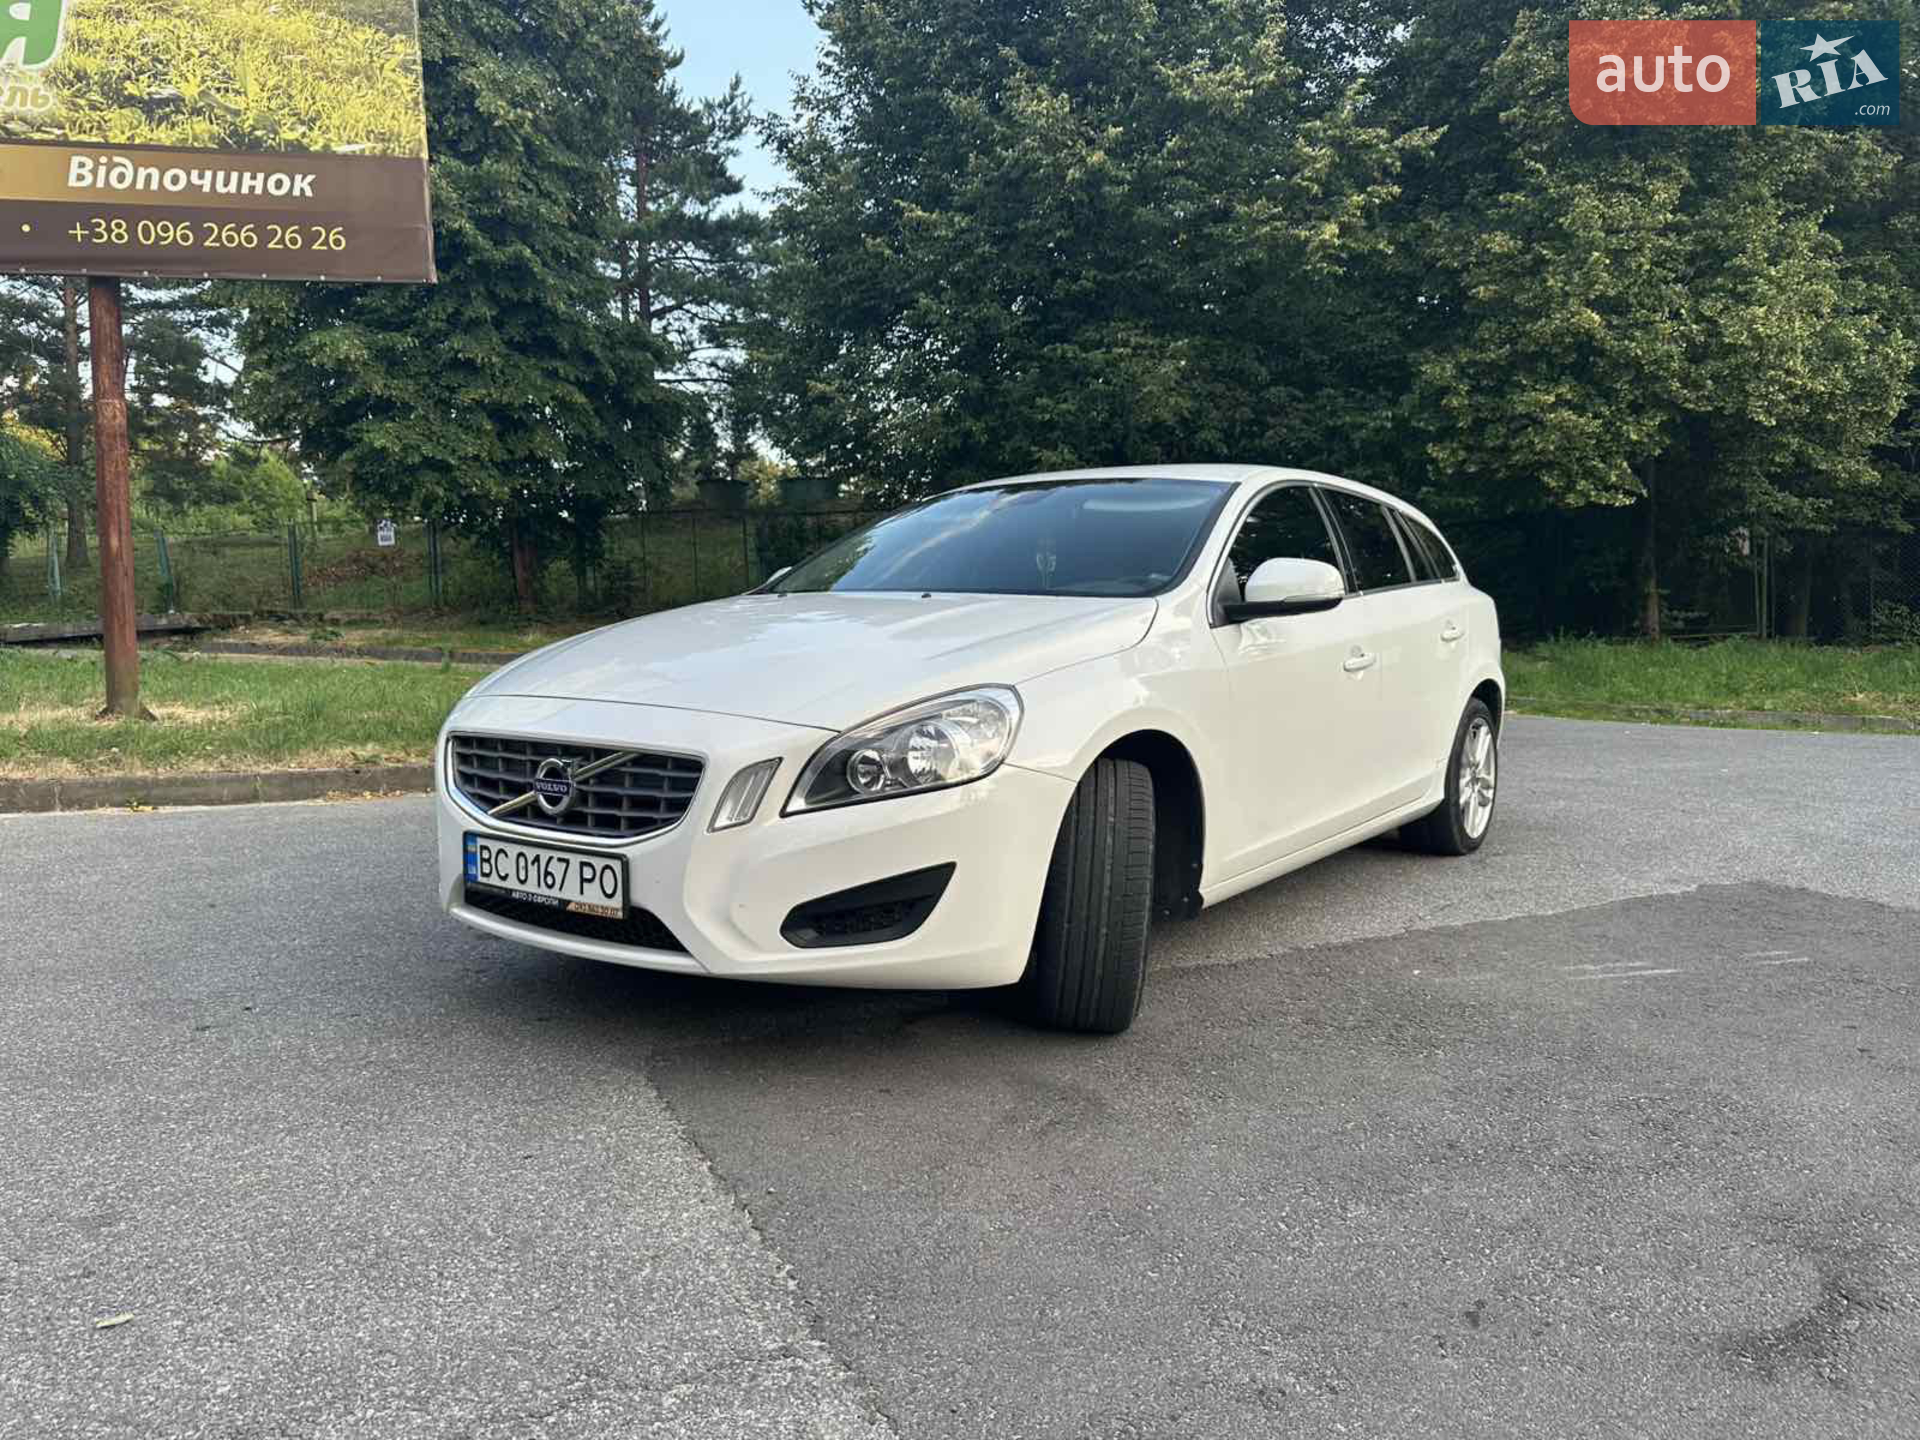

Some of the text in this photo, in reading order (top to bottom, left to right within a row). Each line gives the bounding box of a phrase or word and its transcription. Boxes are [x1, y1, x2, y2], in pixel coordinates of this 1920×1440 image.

[0, 84, 52, 109] ль
[67, 155, 316, 198] Відпочинок
[67, 218, 347, 251] +38 096 266 26 26
[535, 781, 568, 793] VOLVO
[479, 844, 619, 899] BC 0167 PO
